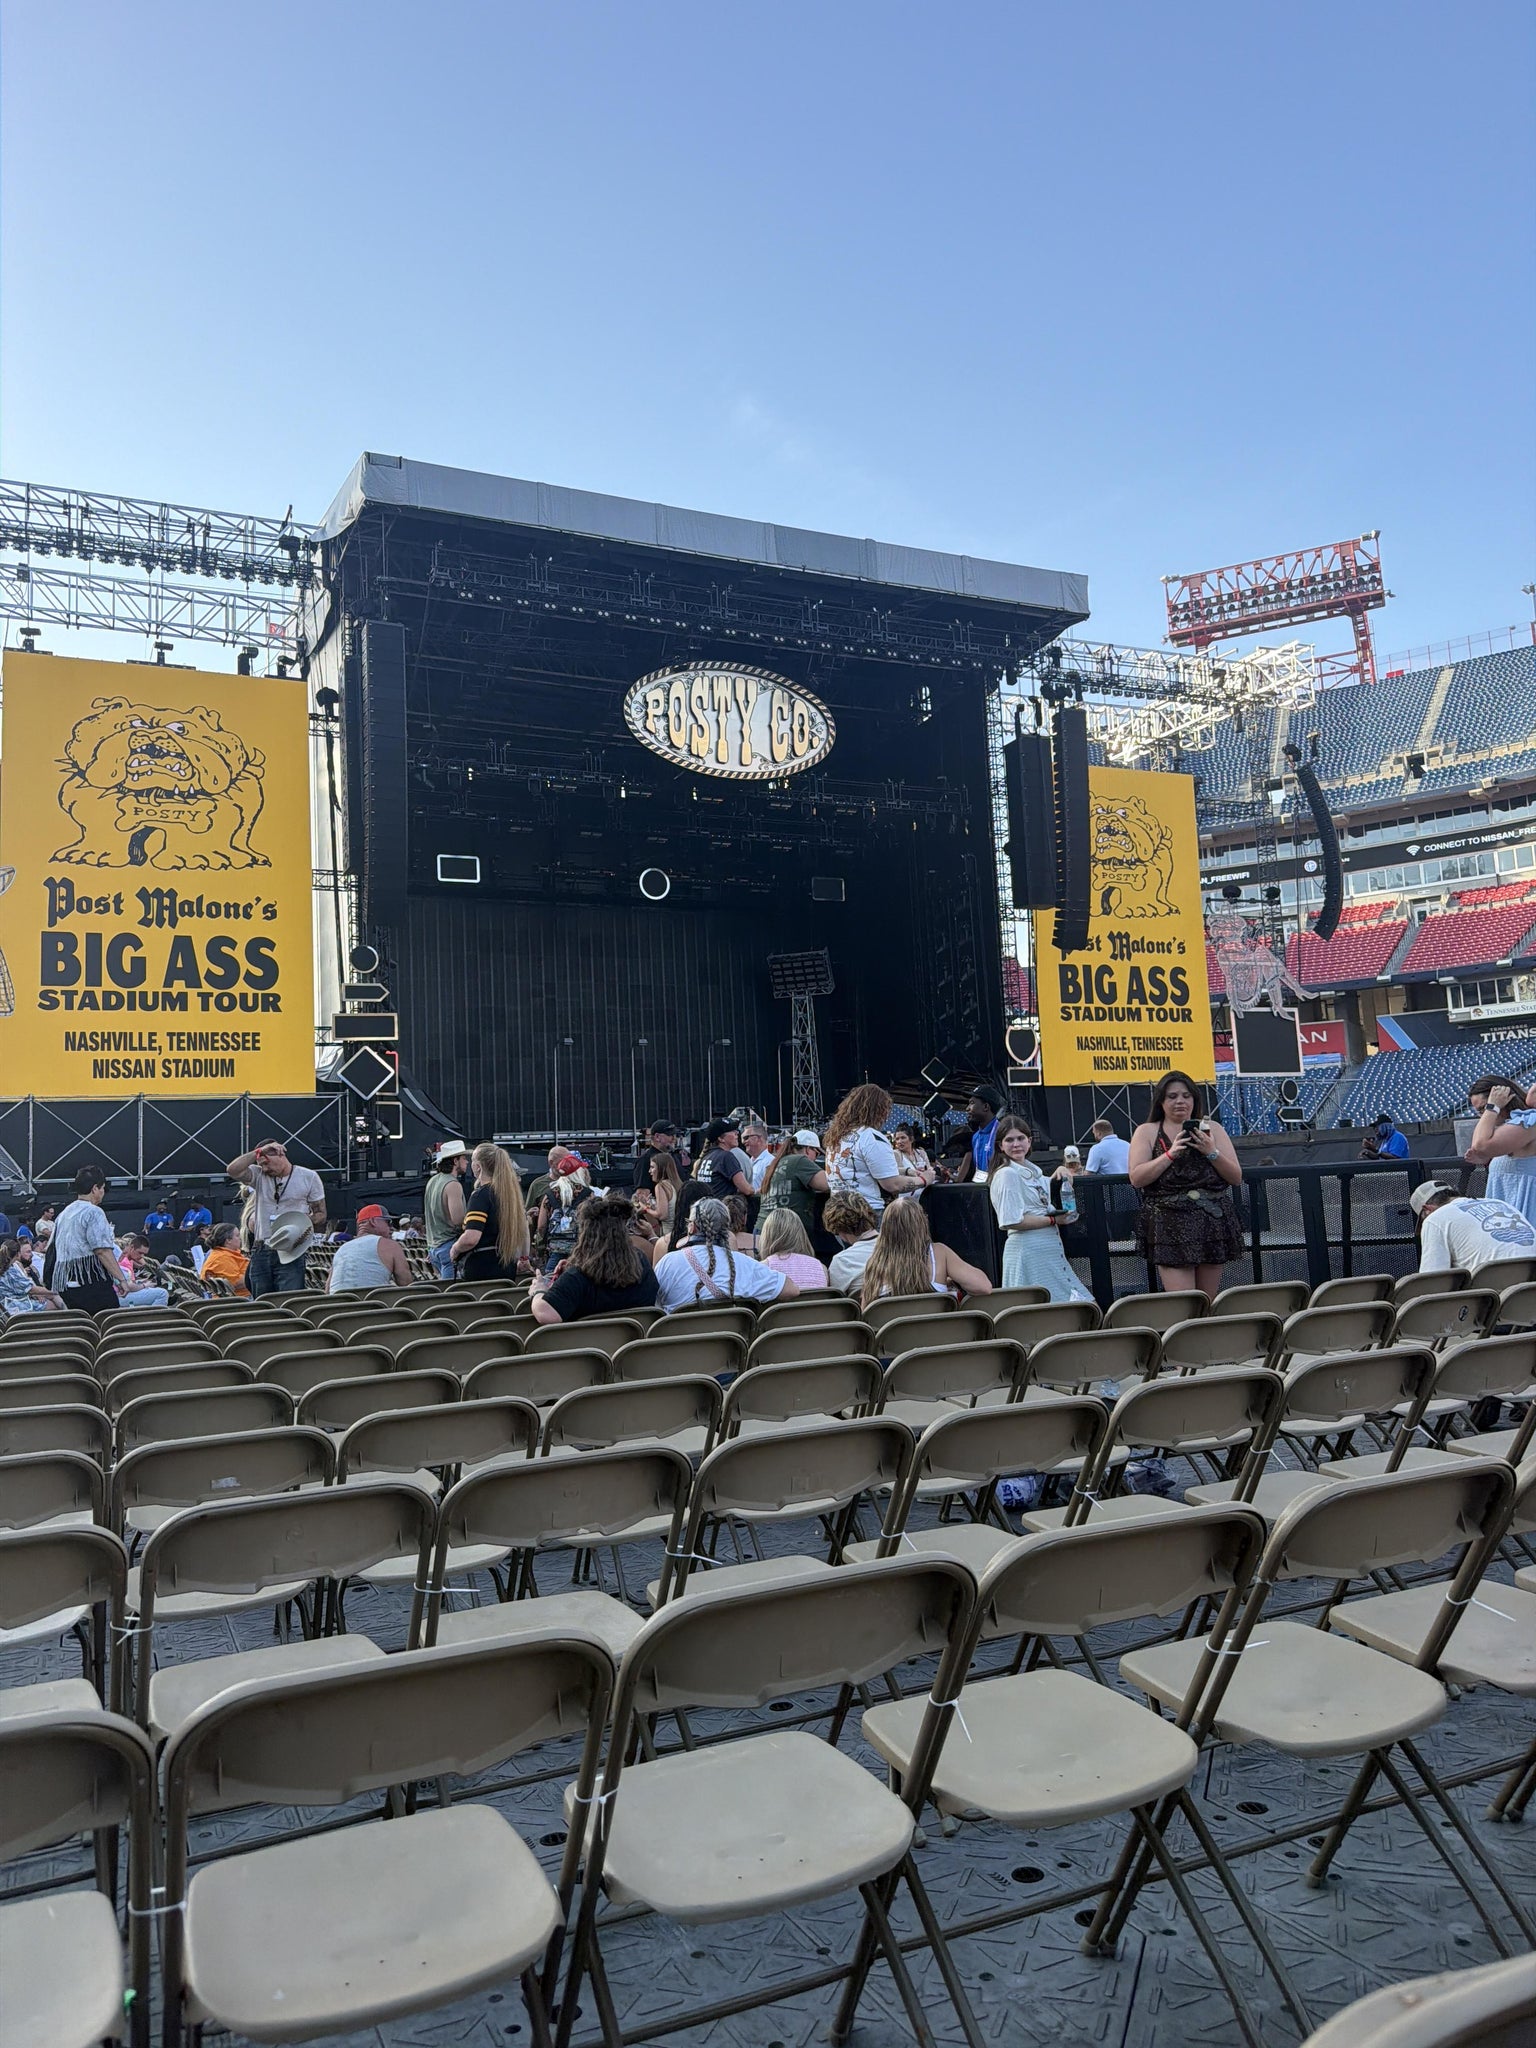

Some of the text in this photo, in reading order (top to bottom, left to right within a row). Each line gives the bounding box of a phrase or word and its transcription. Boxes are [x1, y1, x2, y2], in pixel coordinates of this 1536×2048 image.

[645, 675, 820, 766] POSTY CO.
[133, 807, 201, 821] POSTY
[1423, 838, 1466, 852] CONNECT
[1466, 836, 1480, 845] TO
[1102, 872, 1139, 882] POSTY
[43, 876, 278, 929] Post Malone's
[1107, 930, 1186, 961] Malone's
[40, 931, 280, 991] BIG ASS
[1058, 964, 1190, 1006] BIG ASS
[37, 990, 282, 1013] STADIUM TOUR
[1060, 1006, 1193, 1023] STADIUM TOUR
[64, 1031, 261, 1055] NASHVILLE, TENNESSEE
[1076, 1036, 1184, 1054] NASHVILLE, TENNESSEE
[1480, 1027, 1536, 1043] TITANS
[93, 1058, 235, 1079] NISSAN STADIUM
[1093, 1056, 1171, 1071] NISSAN STADIUM
